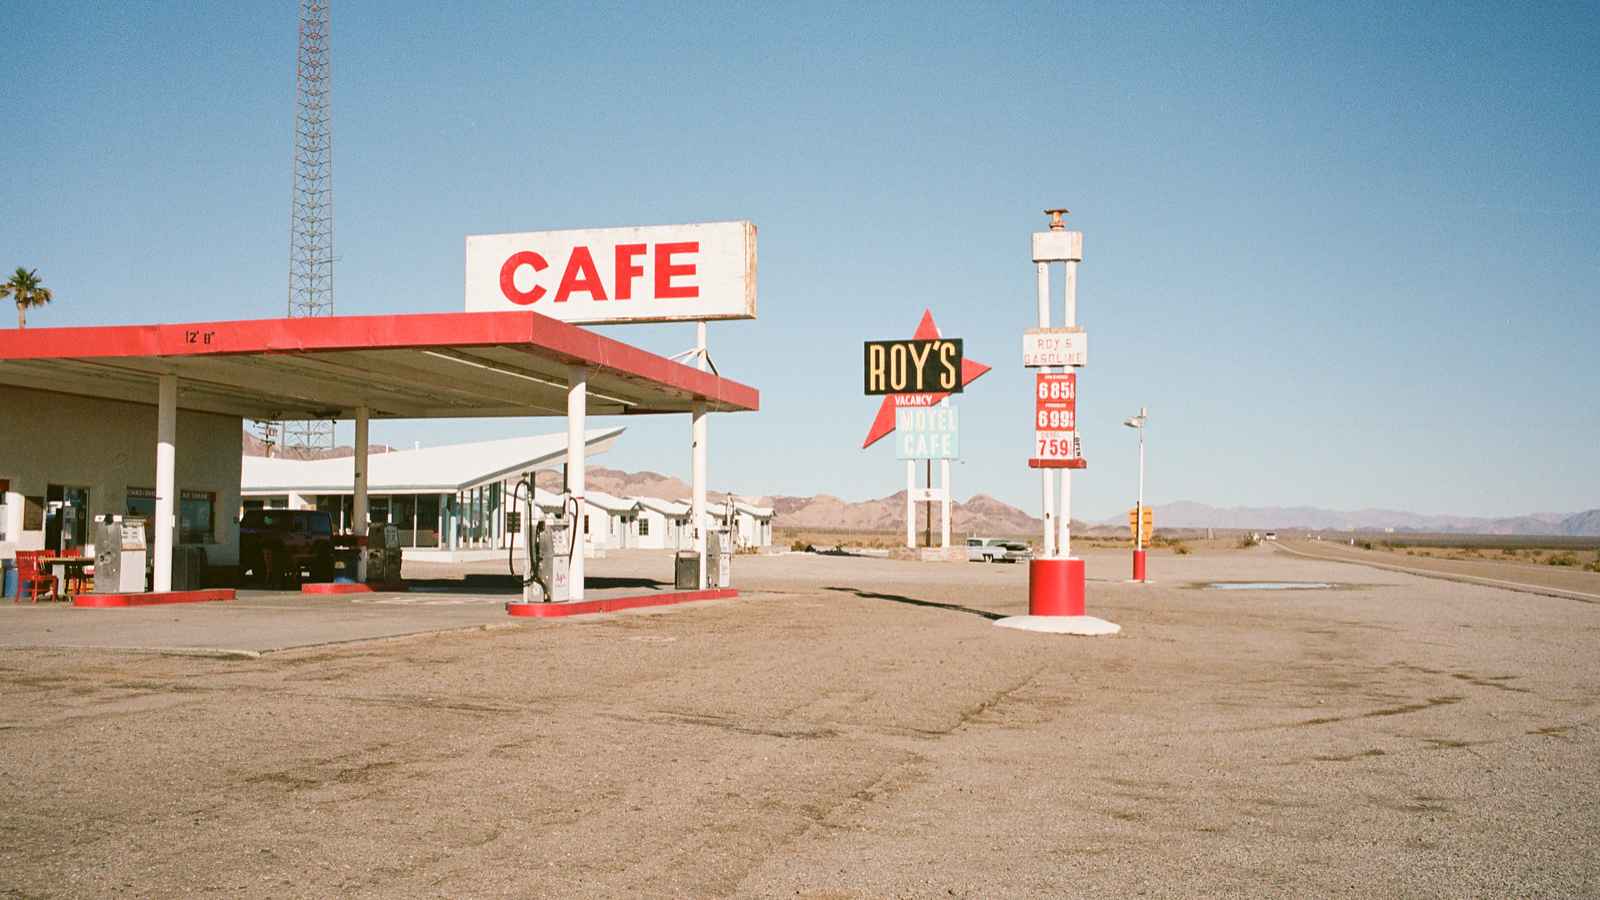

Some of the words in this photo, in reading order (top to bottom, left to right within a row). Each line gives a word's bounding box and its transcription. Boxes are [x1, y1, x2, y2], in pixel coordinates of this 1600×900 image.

[499, 241, 700, 306] CAFE
[1037, 337, 1073, 351] ROYS
[869, 340, 956, 392] ROY'S
[1024, 352, 1081, 364] GASOLINE
[895, 394, 933, 405] VACANCY
[900, 410, 957, 433] MOTEL
[903, 433, 952, 456] CAFE
